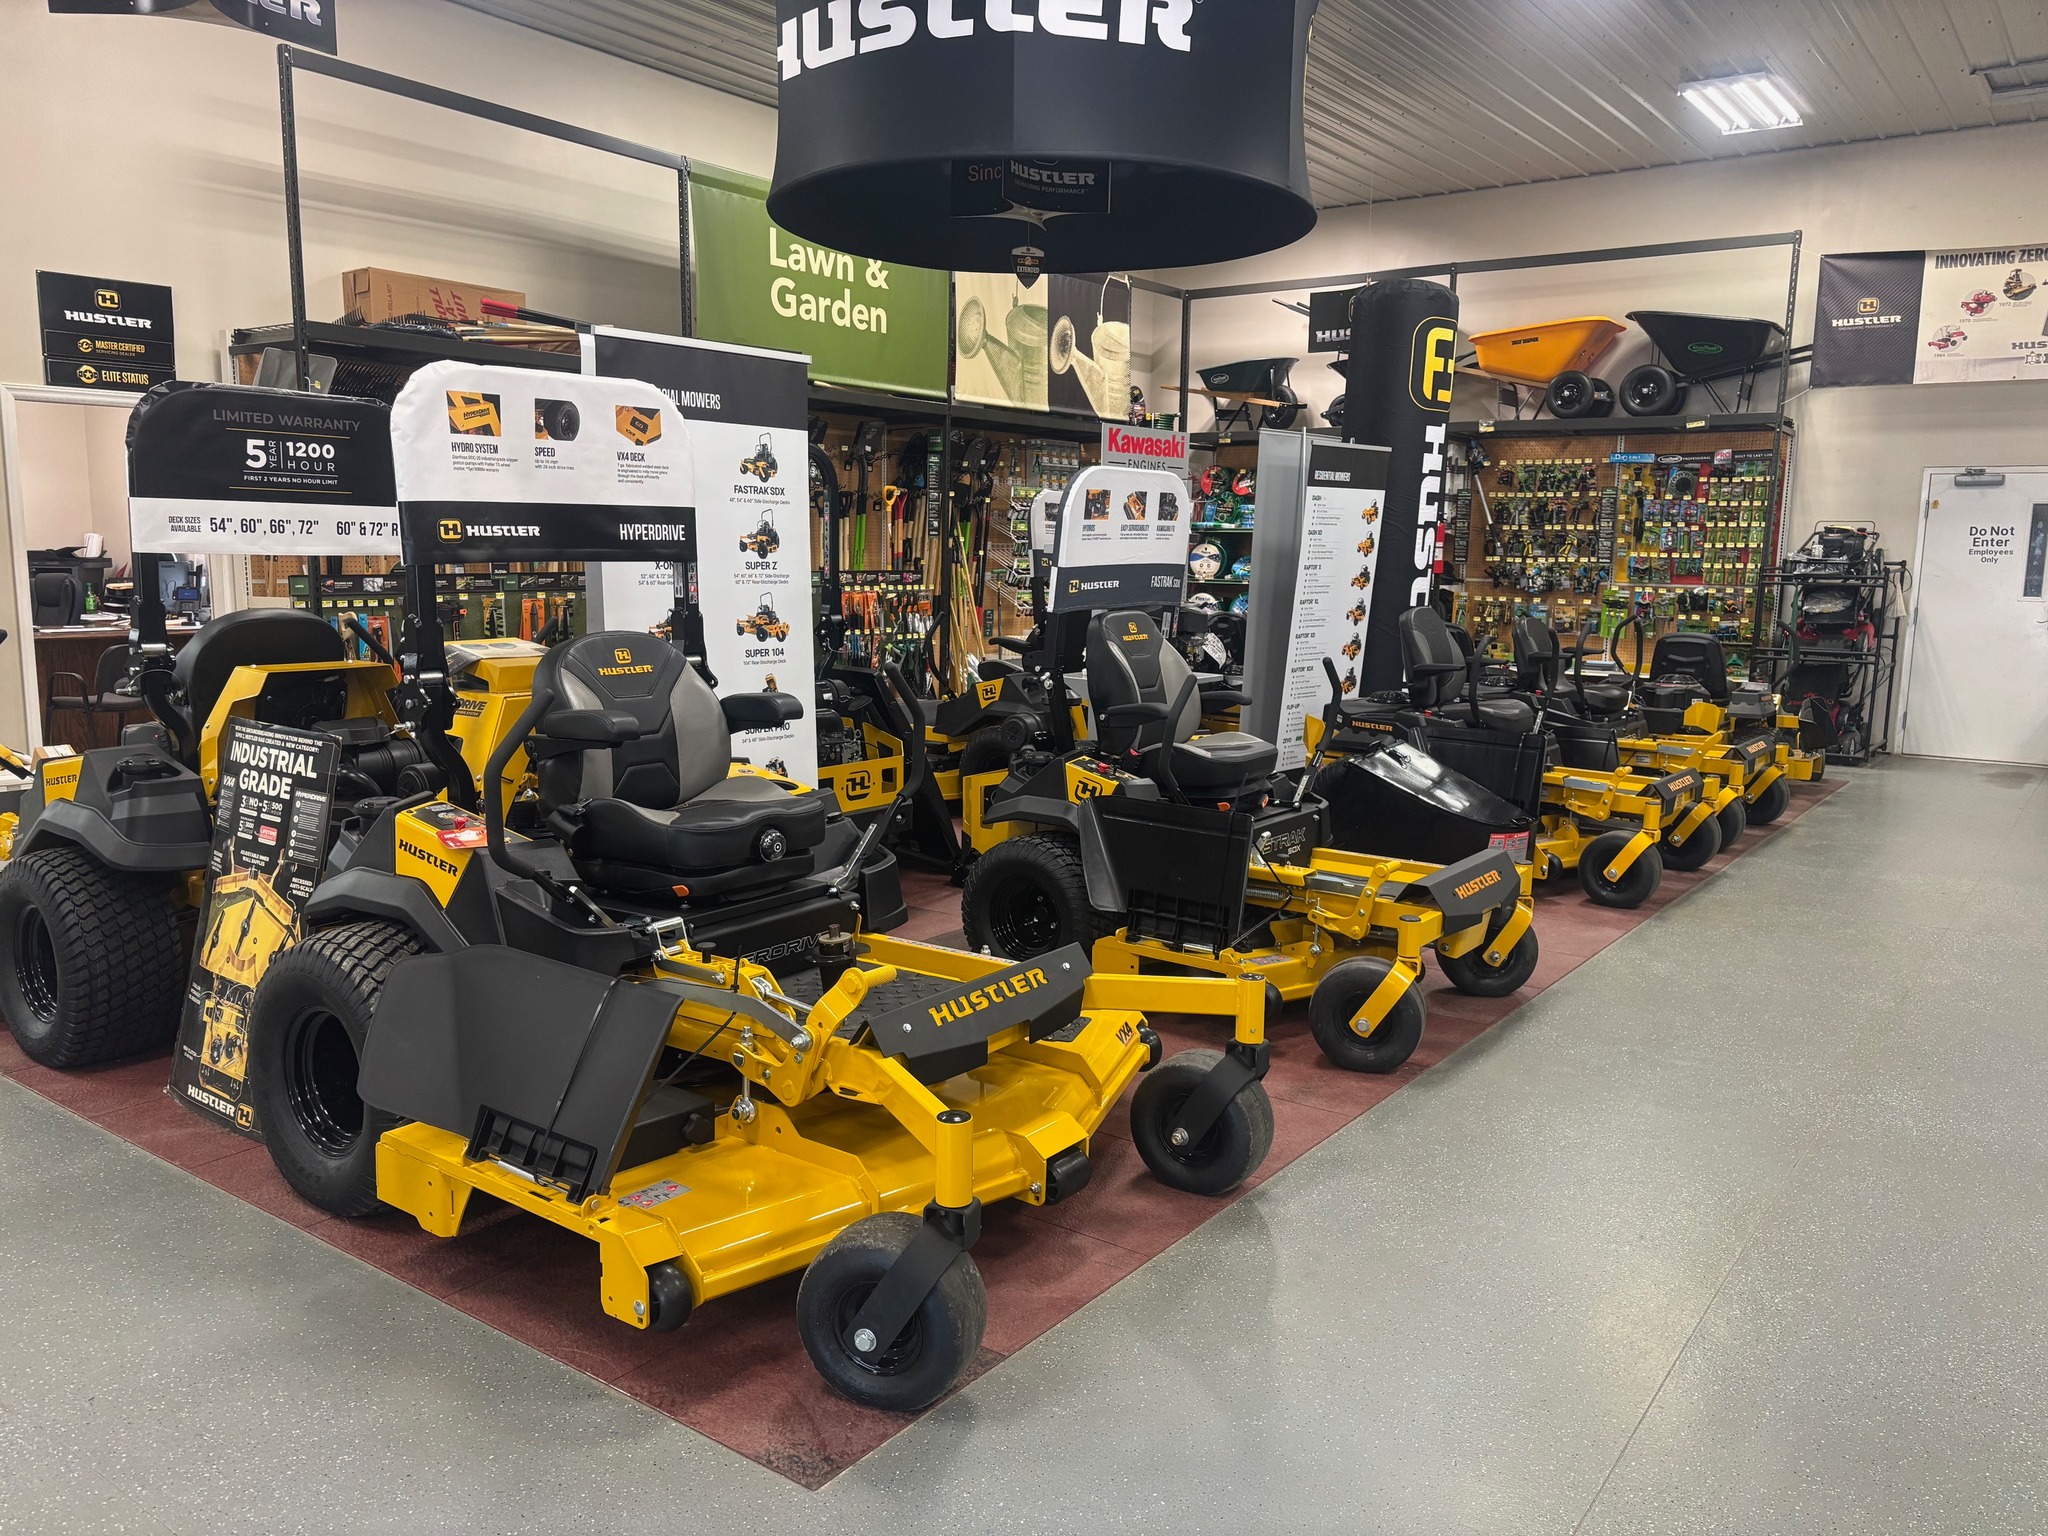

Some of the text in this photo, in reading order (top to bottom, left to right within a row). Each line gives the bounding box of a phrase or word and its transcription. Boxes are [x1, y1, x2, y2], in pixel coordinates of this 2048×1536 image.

[1010, 160, 1095, 185] HUSTLER
[1041, 186, 1086, 195] PERFORMANCE
[770, 227, 889, 290] Lawn &
[1935, 250, 2016, 269] INNOVATING
[771, 277, 887, 334] Garden
[63, 310, 153, 329] HUSTLER
[1831, 315, 1902, 327] HUSTLER
[95, 340, 146, 353] MASTER CERTIFIED
[101, 370, 149, 385] ELITE STATUS
[681, 390, 721, 410] MOWERS
[213, 409, 361, 432] LIMITED WARRANTY
[451, 441, 499, 454] HYDRO SYSTEM
[1107, 427, 1186, 459] Kawasaki
[246, 438, 335, 469] 5 YEAR 1200
[535, 446, 556, 457] SPEED
[617, 451, 646, 462] VX4 DECK
[287, 460, 335, 472] HOUR
[1128, 459, 1166, 471] ENGINES
[269, 476, 291, 484] YEARS
[302, 477, 321, 485] HOUR
[733, 485, 785, 496] FASTRAK SDX
[168, 516, 201, 524] DECK SIZES
[170, 524, 202, 533] AVAILABLE
[210, 517, 237, 534] 54",
[240, 518, 267, 535] 60",
[269, 519, 295, 536] 66",
[298, 520, 319, 535] 72"
[336, 521, 356, 536] 60"
[359, 522, 367, 536] &
[369, 522, 389, 537] 72"
[466, 523, 686, 541] HUSTLER HYPERDRIVE
[1969, 526, 2015, 536] Do Not
[1972, 537, 2010, 547] Enter
[1968, 549, 2014, 557] Employees
[745, 561, 778, 570] SUPER Z
[1981, 556, 1998, 564] Only
[1081, 580, 1120, 591] HUSTLER
[1150, 575, 1174, 588] FASTRAK
[745, 648, 785, 658] SUPER 104
[598, 665, 653, 676] HUSTLER
[1351, 720, 1394, 732] HUSTLER
[230, 740, 318, 779] INDUSTRIAL
[45, 774, 78, 787] HUSTLER
[223, 775, 236, 788] VX4
[239, 768, 292, 800] GRADE
[1667, 775, 1695, 792] HUSTLER
[295, 790, 328, 803] HYPERDRIVE
[248, 797, 259, 806] NO
[271, 801, 283, 811] 500
[398, 838, 458, 878] HUSTLER
[1454, 869, 1501, 900] HUSTLER
[928, 968, 1050, 1028] HUSTLER
[1115, 1021, 1133, 1044] VX4
[187, 1084, 236, 1117] HUSTLER
